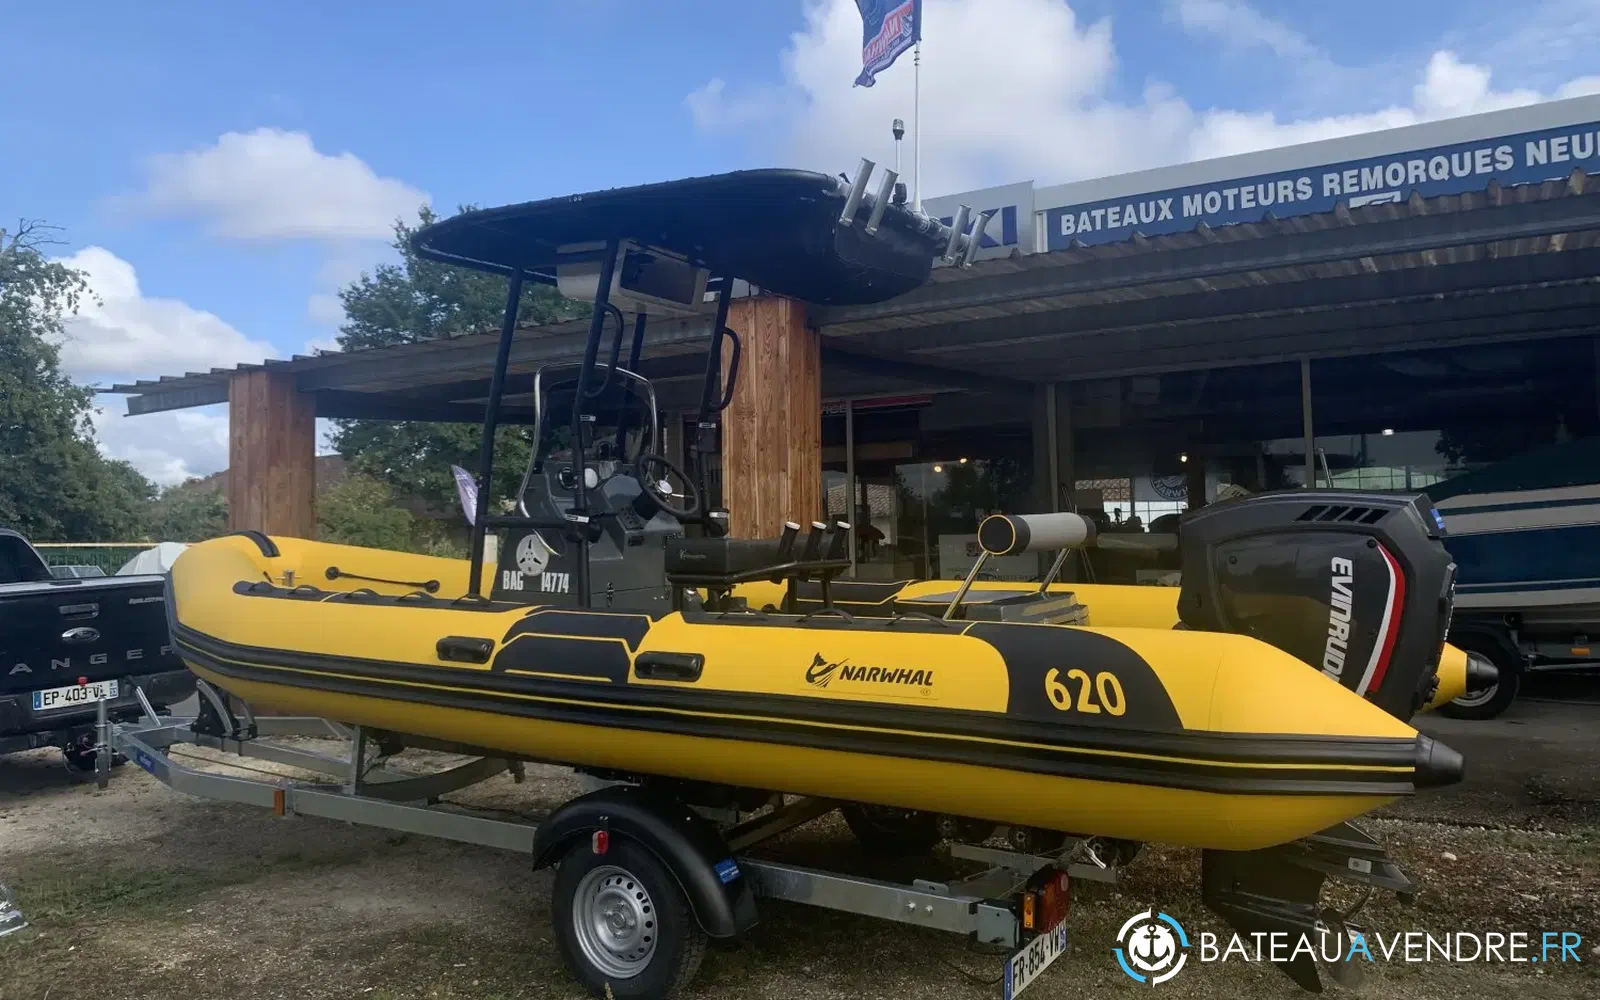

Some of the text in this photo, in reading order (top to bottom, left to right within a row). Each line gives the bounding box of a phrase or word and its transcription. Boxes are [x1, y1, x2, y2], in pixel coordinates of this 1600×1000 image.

[1060, 130, 1600, 237] BATEAUX MOTEURS REMORQUES NEU
[1320, 556, 1354, 684] EVINRUD
[838, 664, 935, 687] NARWHAL
[1044, 667, 1127, 717] 620
